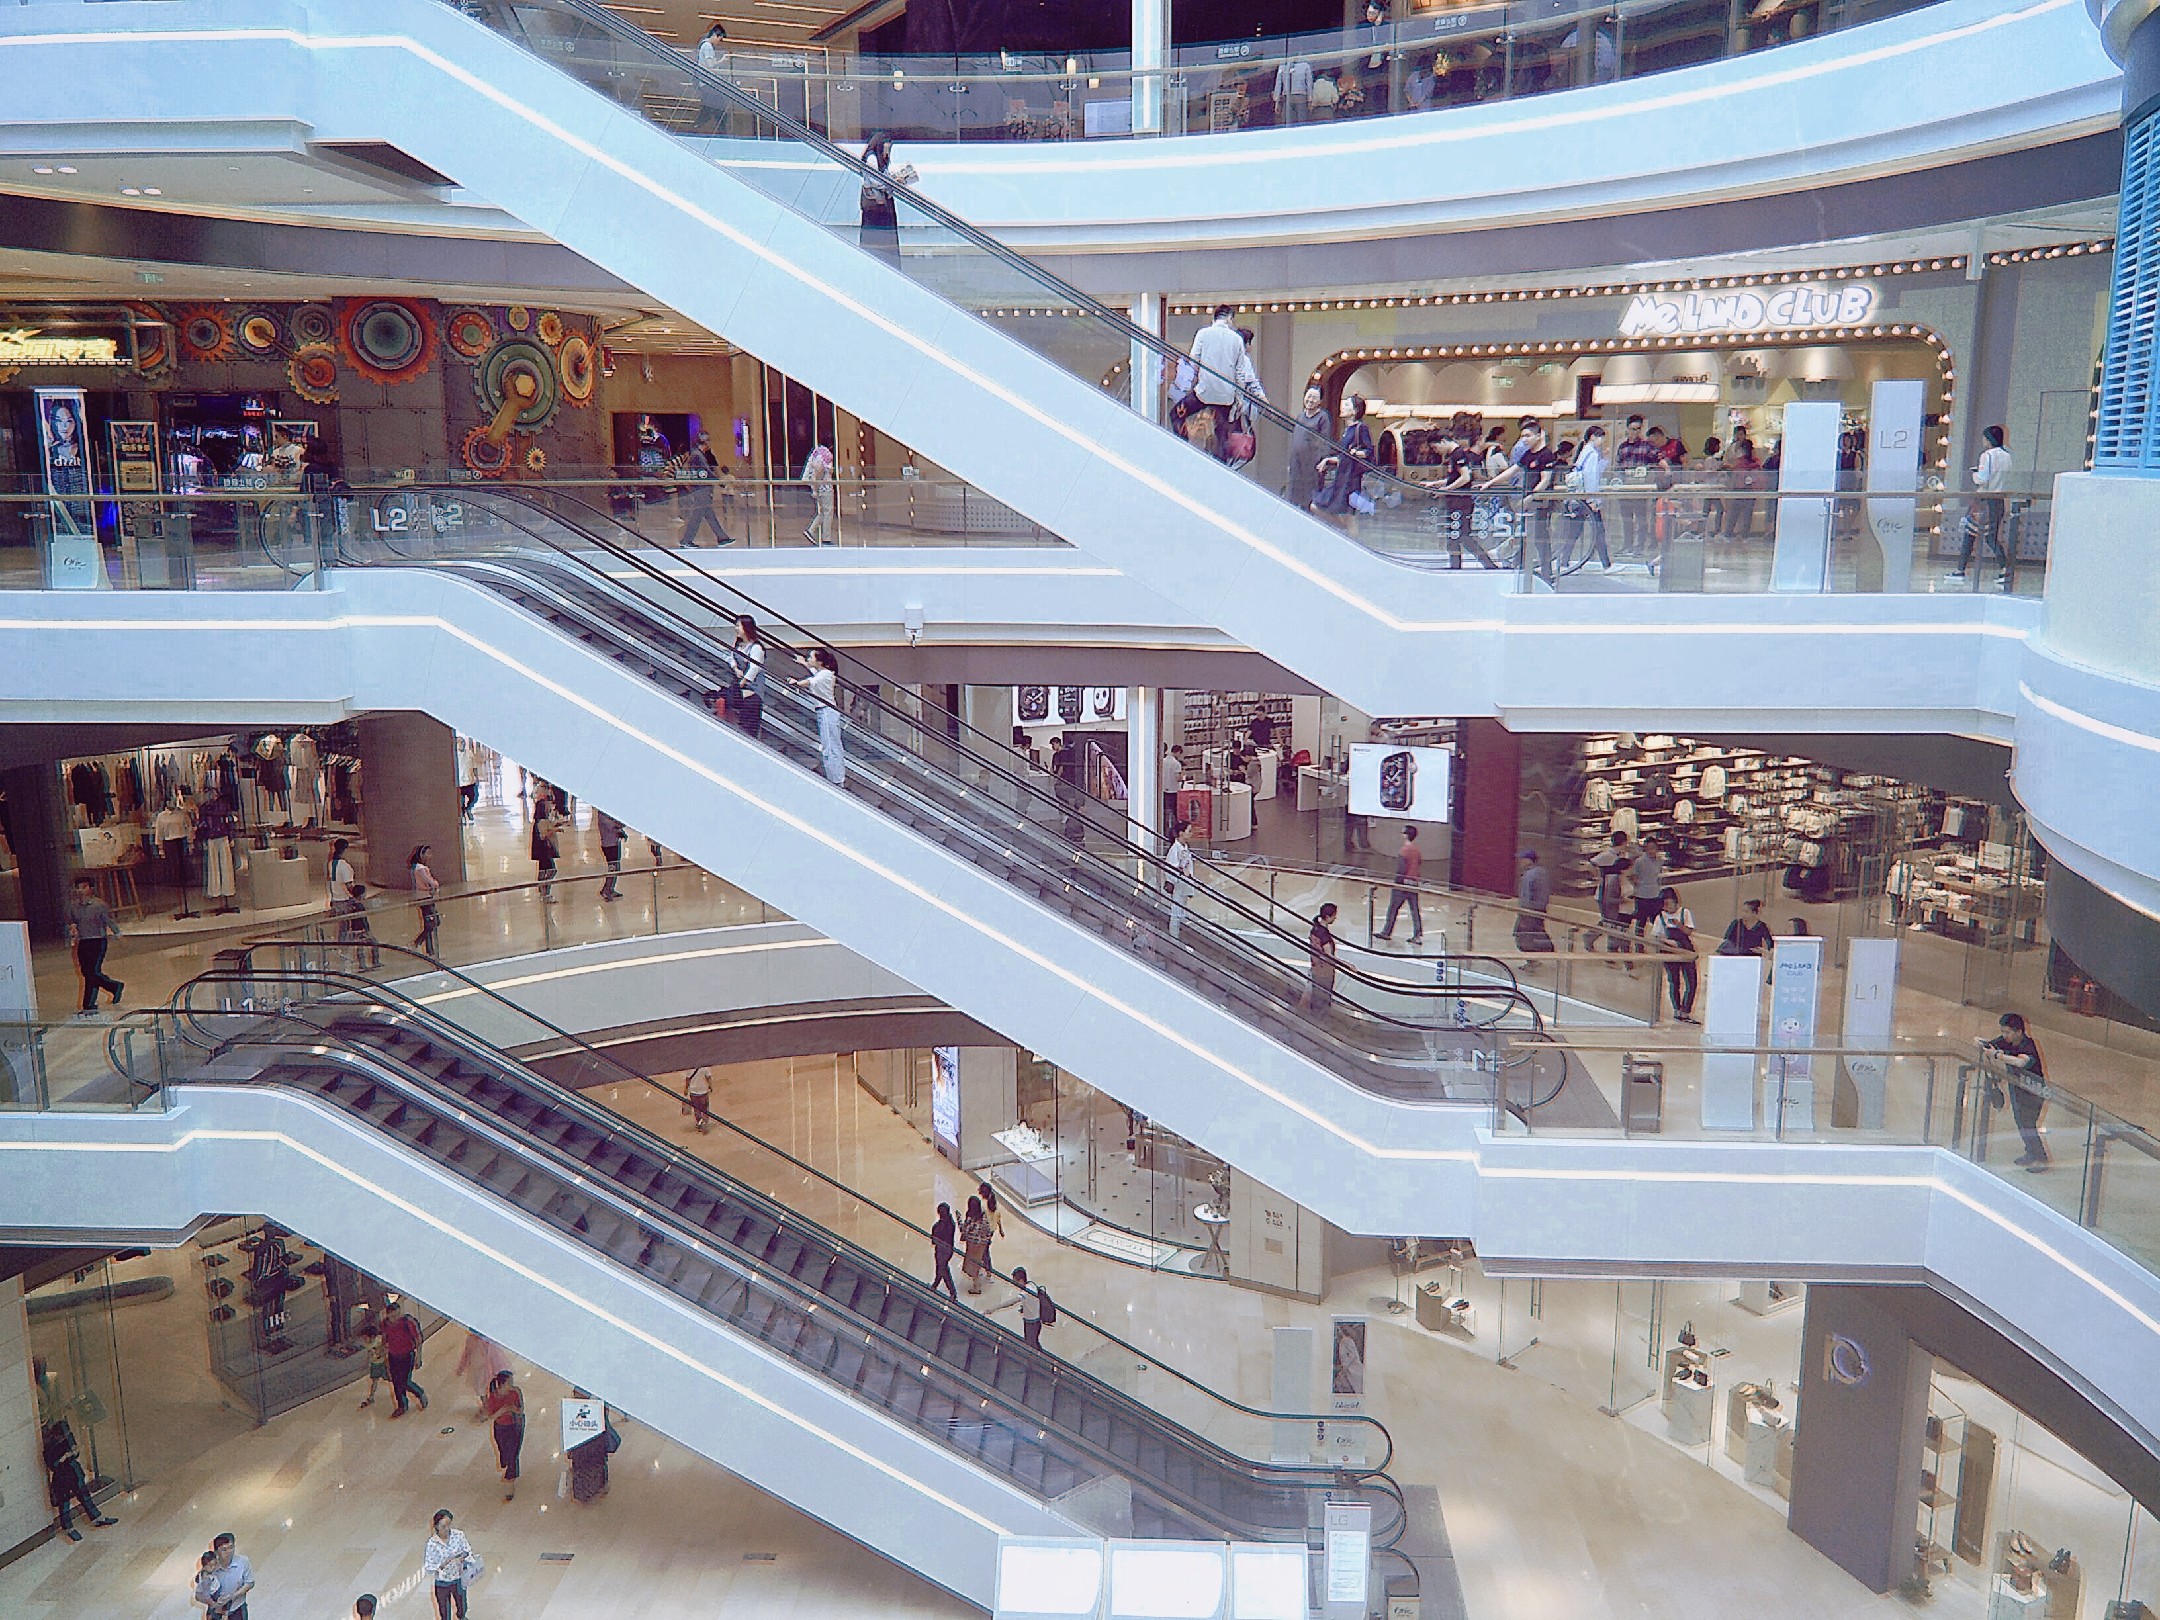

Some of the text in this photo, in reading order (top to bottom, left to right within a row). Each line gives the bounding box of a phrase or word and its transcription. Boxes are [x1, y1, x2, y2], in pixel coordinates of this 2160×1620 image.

[1766, 286, 1873, 326] CLUB
[1880, 430, 1908, 449] L2
[371, 507, 409, 532] L2
[1854, 983, 1878, 1000] L1
[1330, 1515, 1348, 1526] LG
